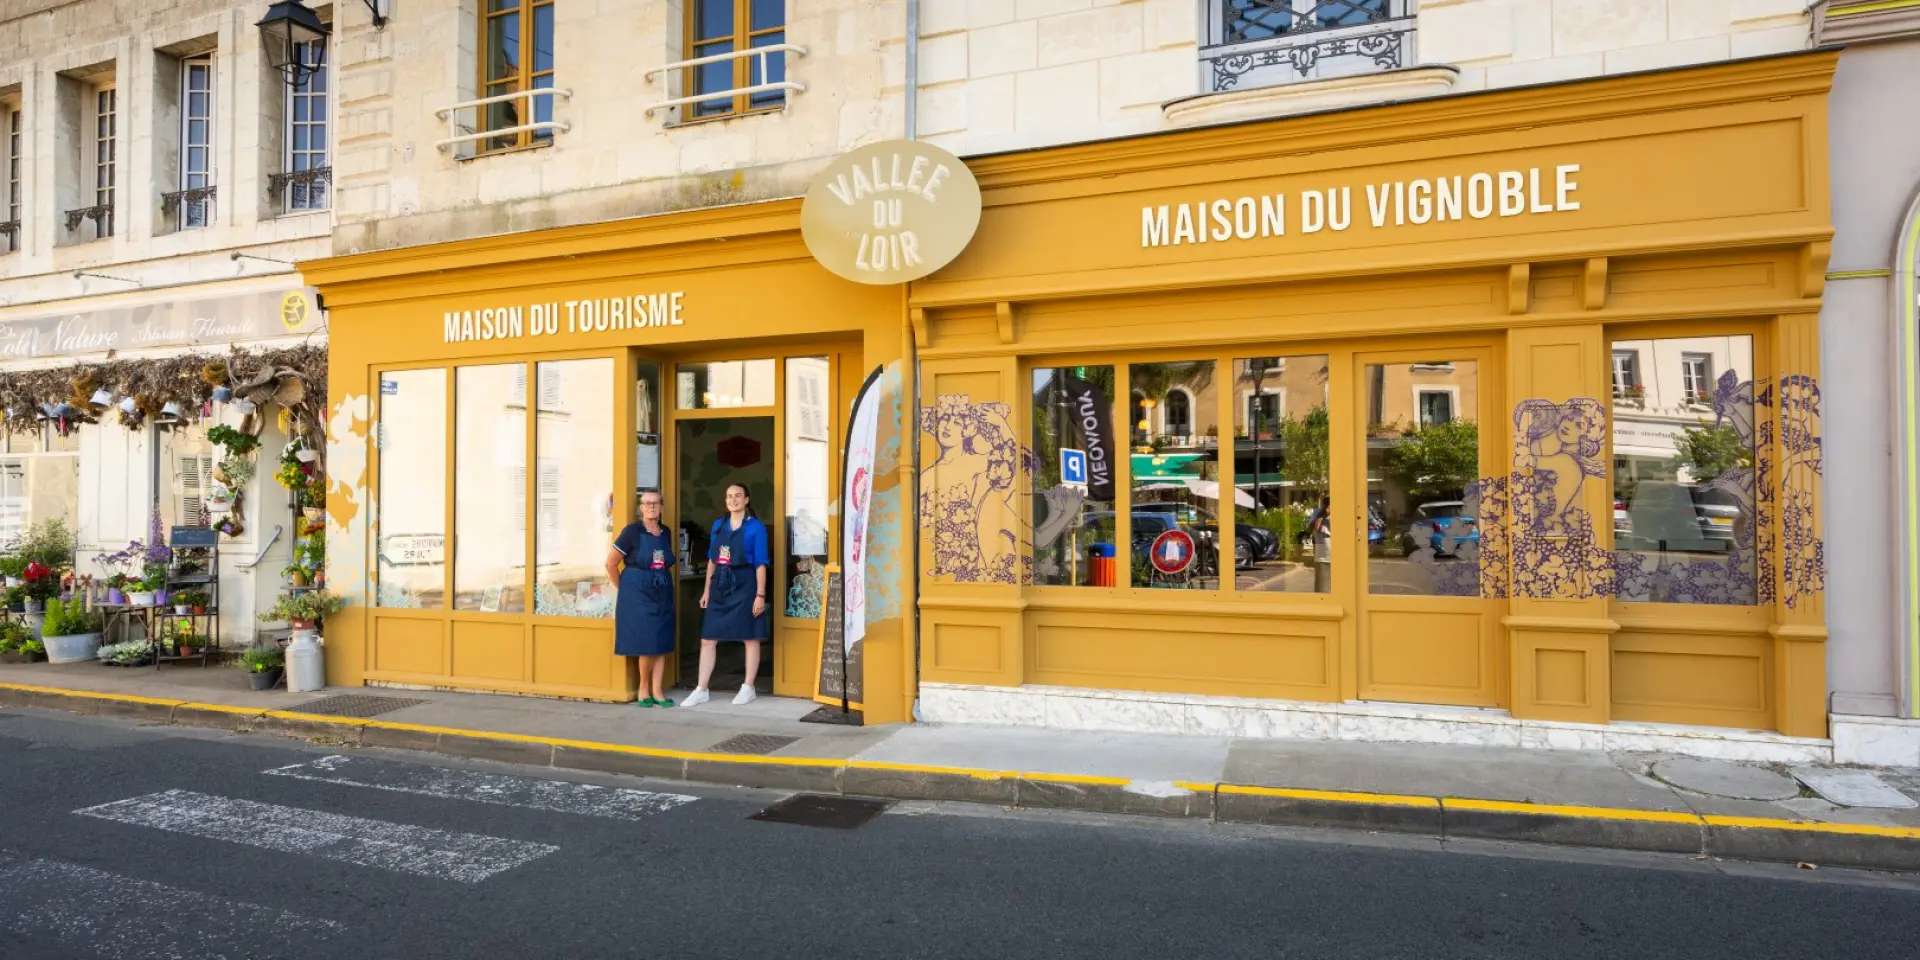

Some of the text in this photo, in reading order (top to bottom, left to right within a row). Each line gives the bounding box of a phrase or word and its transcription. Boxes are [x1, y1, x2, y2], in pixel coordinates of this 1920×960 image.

[827, 153, 950, 206] VALLEE
[873, 199, 903, 229] DU
[1141, 164, 1581, 248] MAISON DU VIGNOBLE
[855, 230, 924, 271] LOIR
[41, 315, 118, 352] Nature
[132, 316, 252, 342] Artisan Fleuriste
[443, 291, 685, 343] MAISON DU TOURISME
